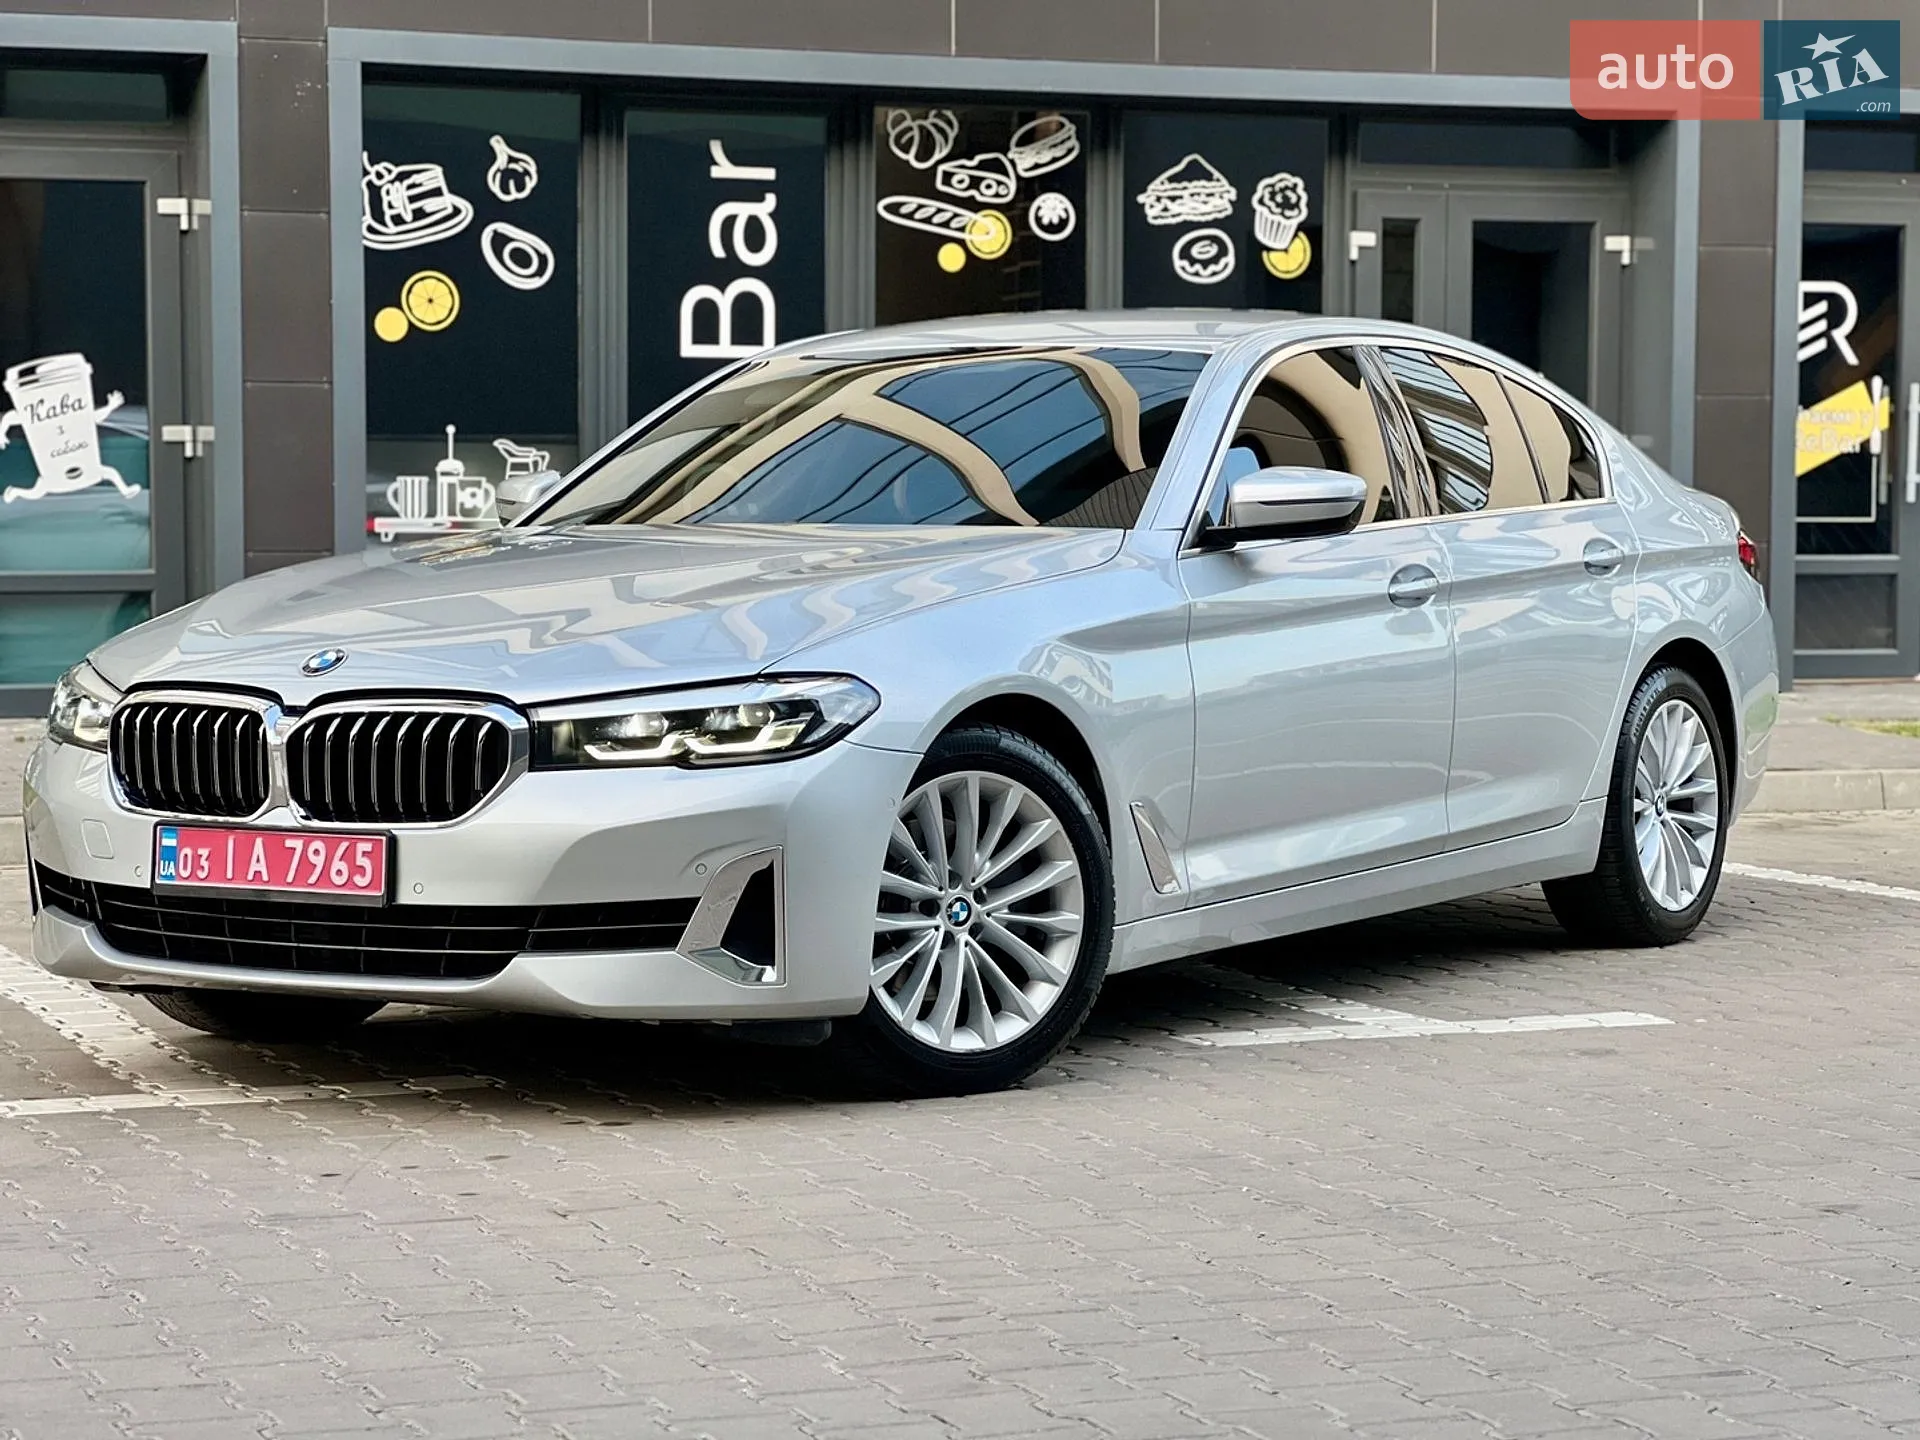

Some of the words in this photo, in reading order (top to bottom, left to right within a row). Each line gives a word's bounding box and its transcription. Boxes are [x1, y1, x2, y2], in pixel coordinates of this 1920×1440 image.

[679, 138, 778, 359] Bar
[23, 393, 88, 425] Кава
[159, 860, 176, 877] UA
[178, 846, 211, 880] 03
[283, 838, 374, 888] 7965
